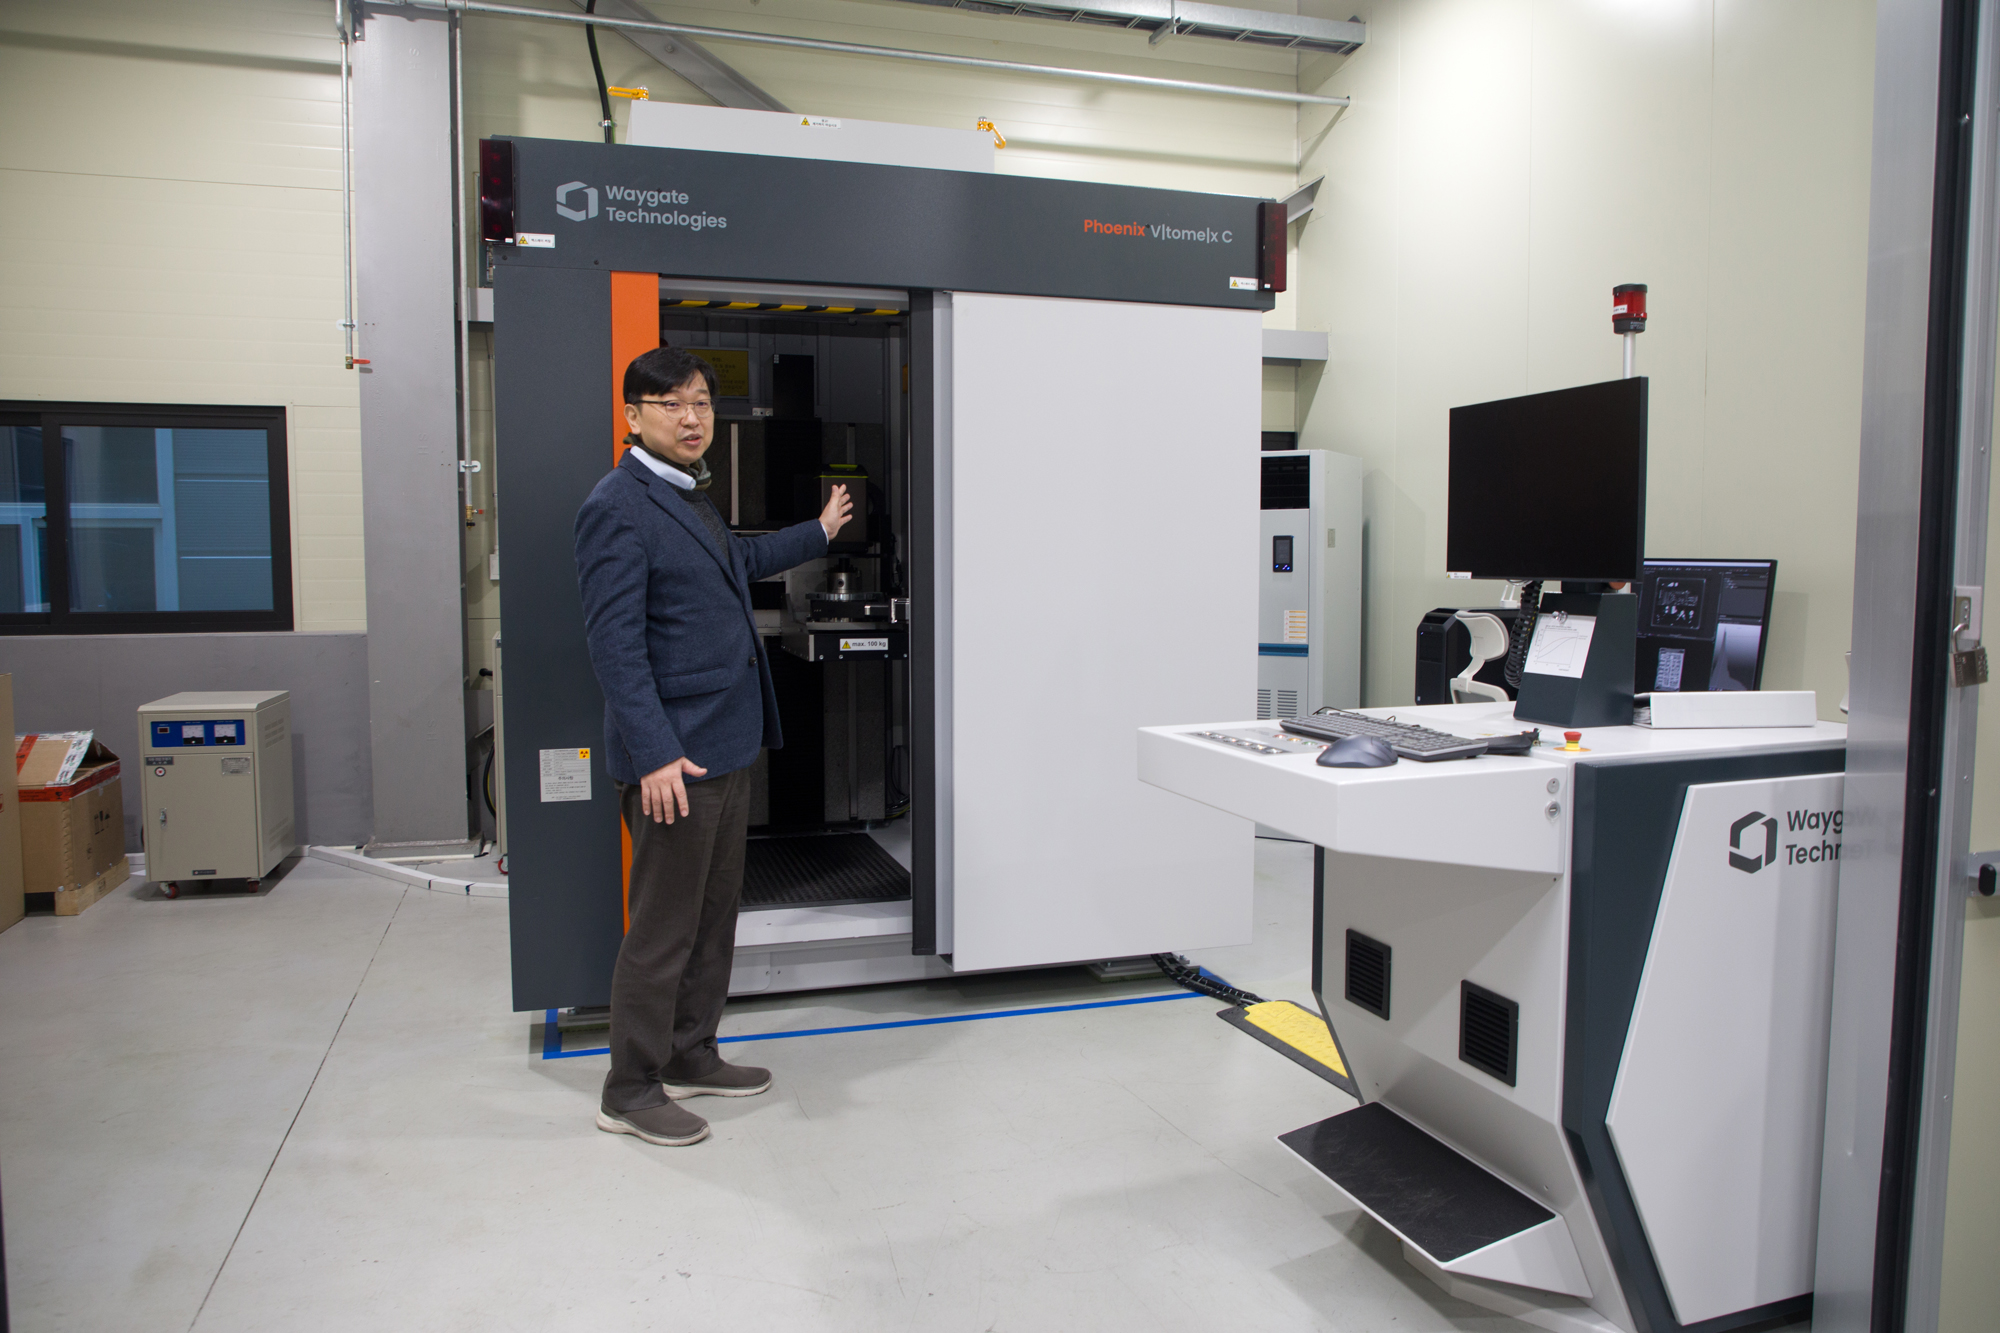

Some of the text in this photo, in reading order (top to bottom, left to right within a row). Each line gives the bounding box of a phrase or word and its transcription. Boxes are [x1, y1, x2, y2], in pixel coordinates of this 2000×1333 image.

[605, 185, 689, 207] Waygate
[605, 207, 727, 231] Technologies
[1084, 219, 1146, 237] Phoenix
[1221, 230, 1233, 243] C
